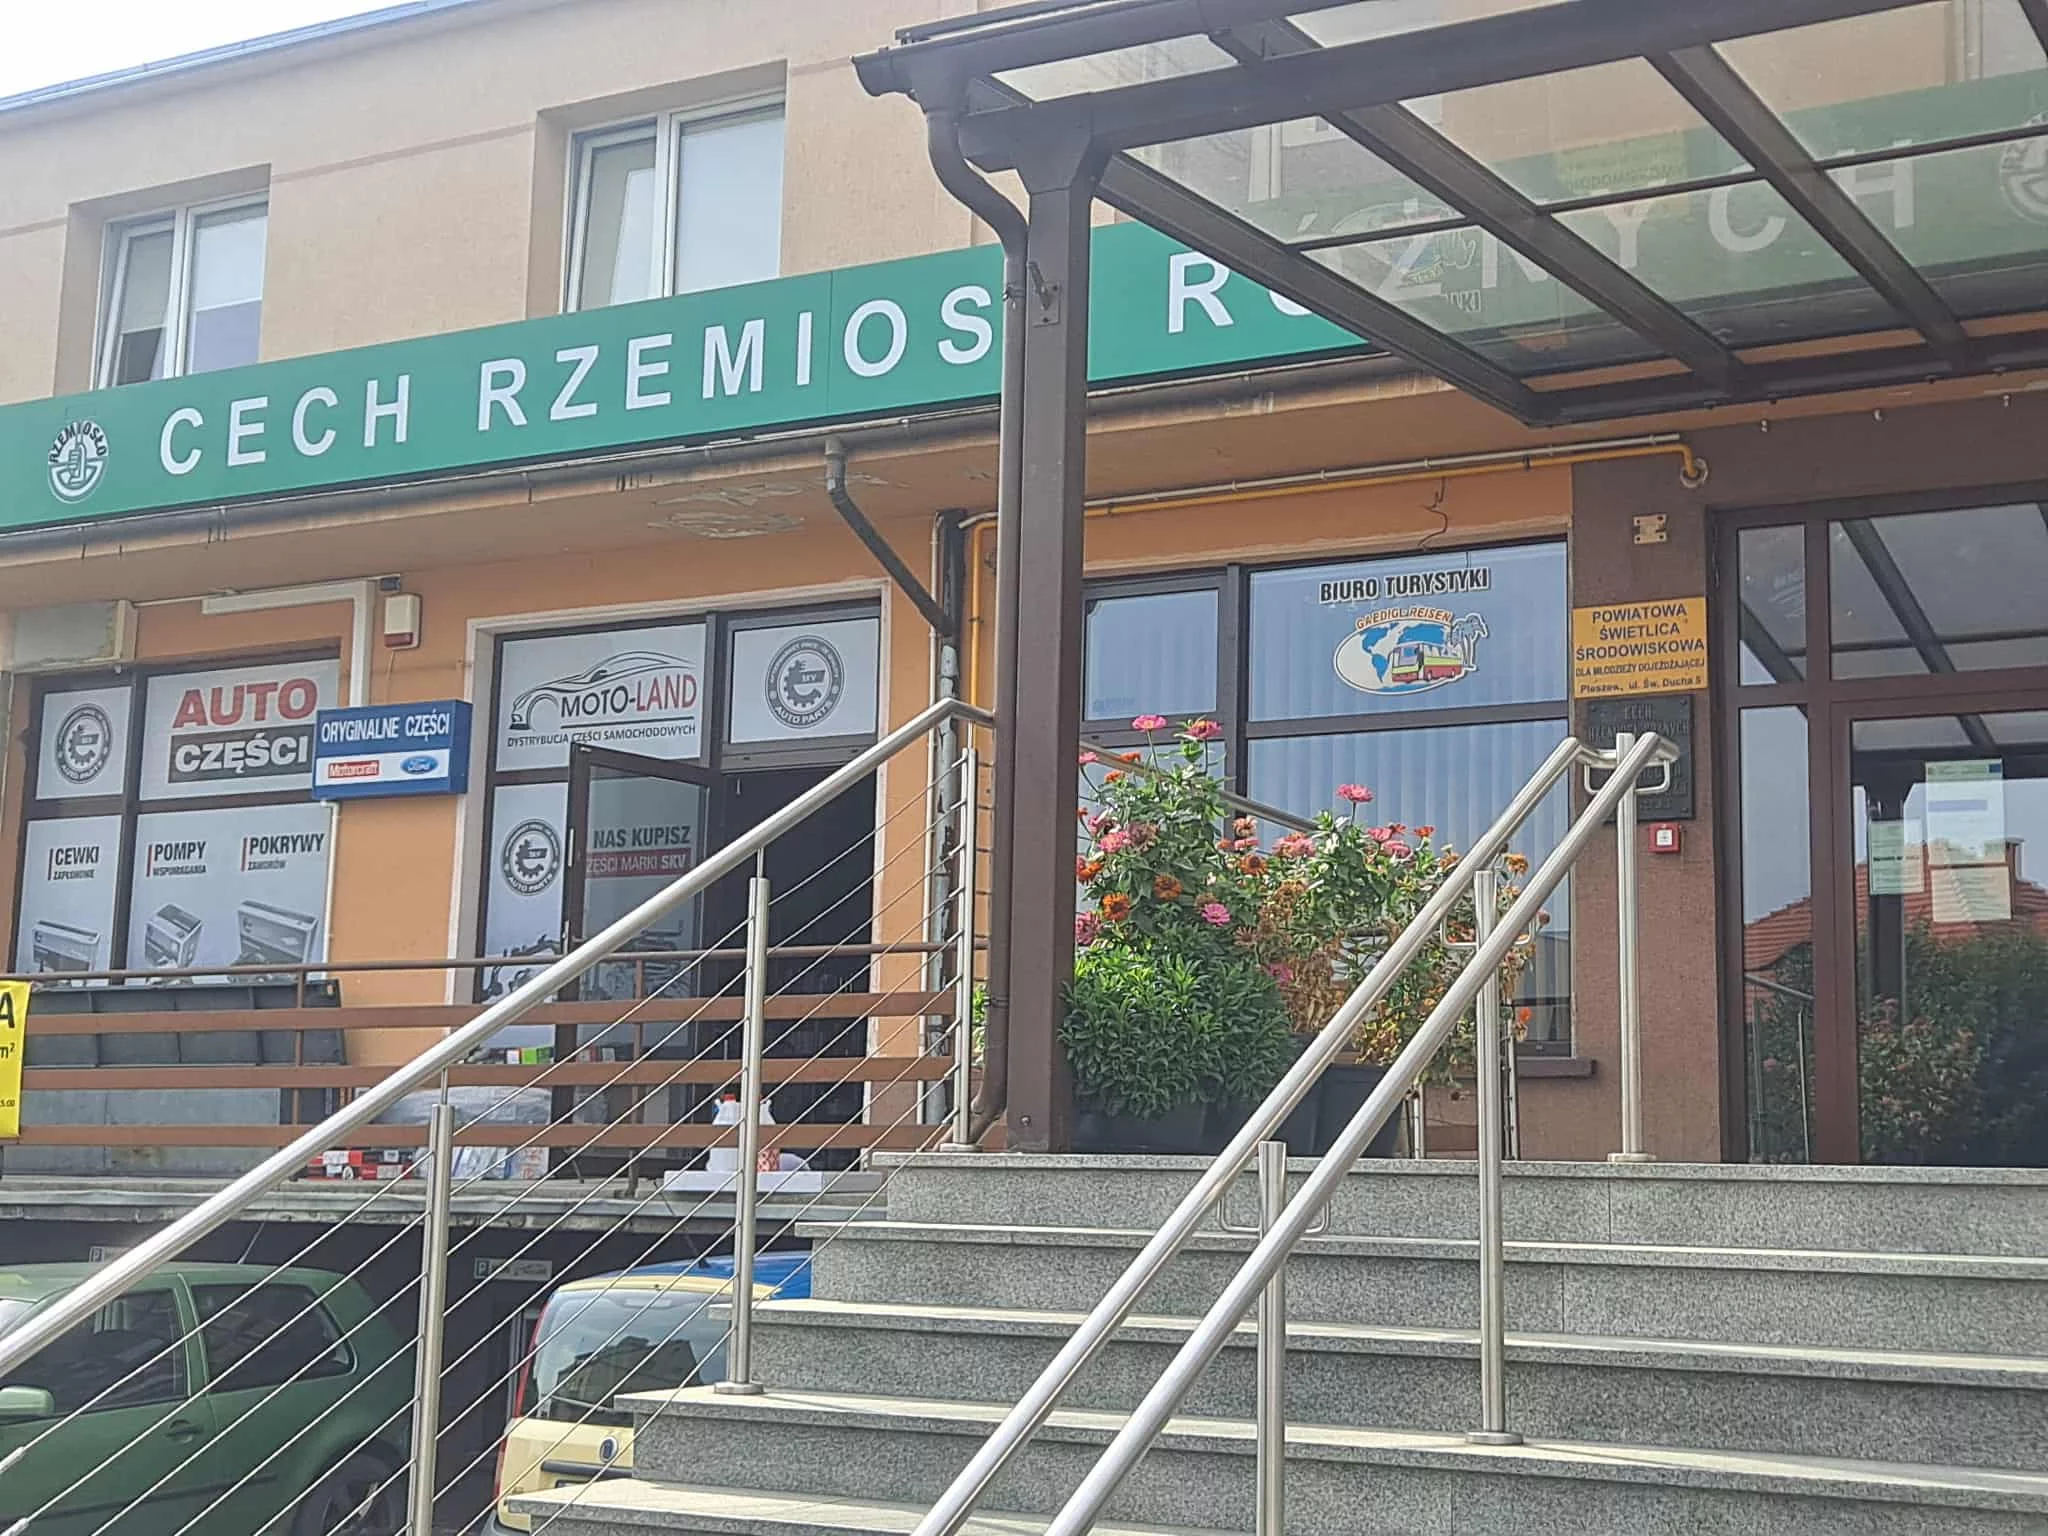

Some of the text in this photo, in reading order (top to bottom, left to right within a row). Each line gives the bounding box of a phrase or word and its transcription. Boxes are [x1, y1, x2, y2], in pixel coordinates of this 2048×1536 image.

[159, 374, 410, 475] CECH
[477, 284, 993, 432] RZEMIOS
[1320, 568, 1489, 602] BIURO TURYSTYKI
[1409, 607, 1453, 623] REISEN
[1592, 603, 1688, 624] POWIATOWA
[1600, 622, 1681, 641] ŚWIETLICA
[1576, 638, 1705, 661] ŚRODOWISKOWA
[1576, 667, 1592, 677] DLA
[1662, 678, 1693, 688] Ducha
[172, 678, 318, 729] AUTO
[560, 674, 698, 718] MOTO-LAND
[321, 708, 450, 744] ORYGINALNE CZĘŚCI
[507, 724, 697, 748] DYSTRYBUCJA CZĘŚCI SAMOCHODOWYCH
[175, 732, 308, 774] CZĘŚCI
[250, 834, 325, 855] POKRYWY
[594, 825, 691, 849] NAS KUPISZ
[55, 846, 100, 866] CEWKI
[154, 841, 207, 862] POMPY
[622, 856, 658, 873] MARKI
[661, 853, 687, 870] SKV
